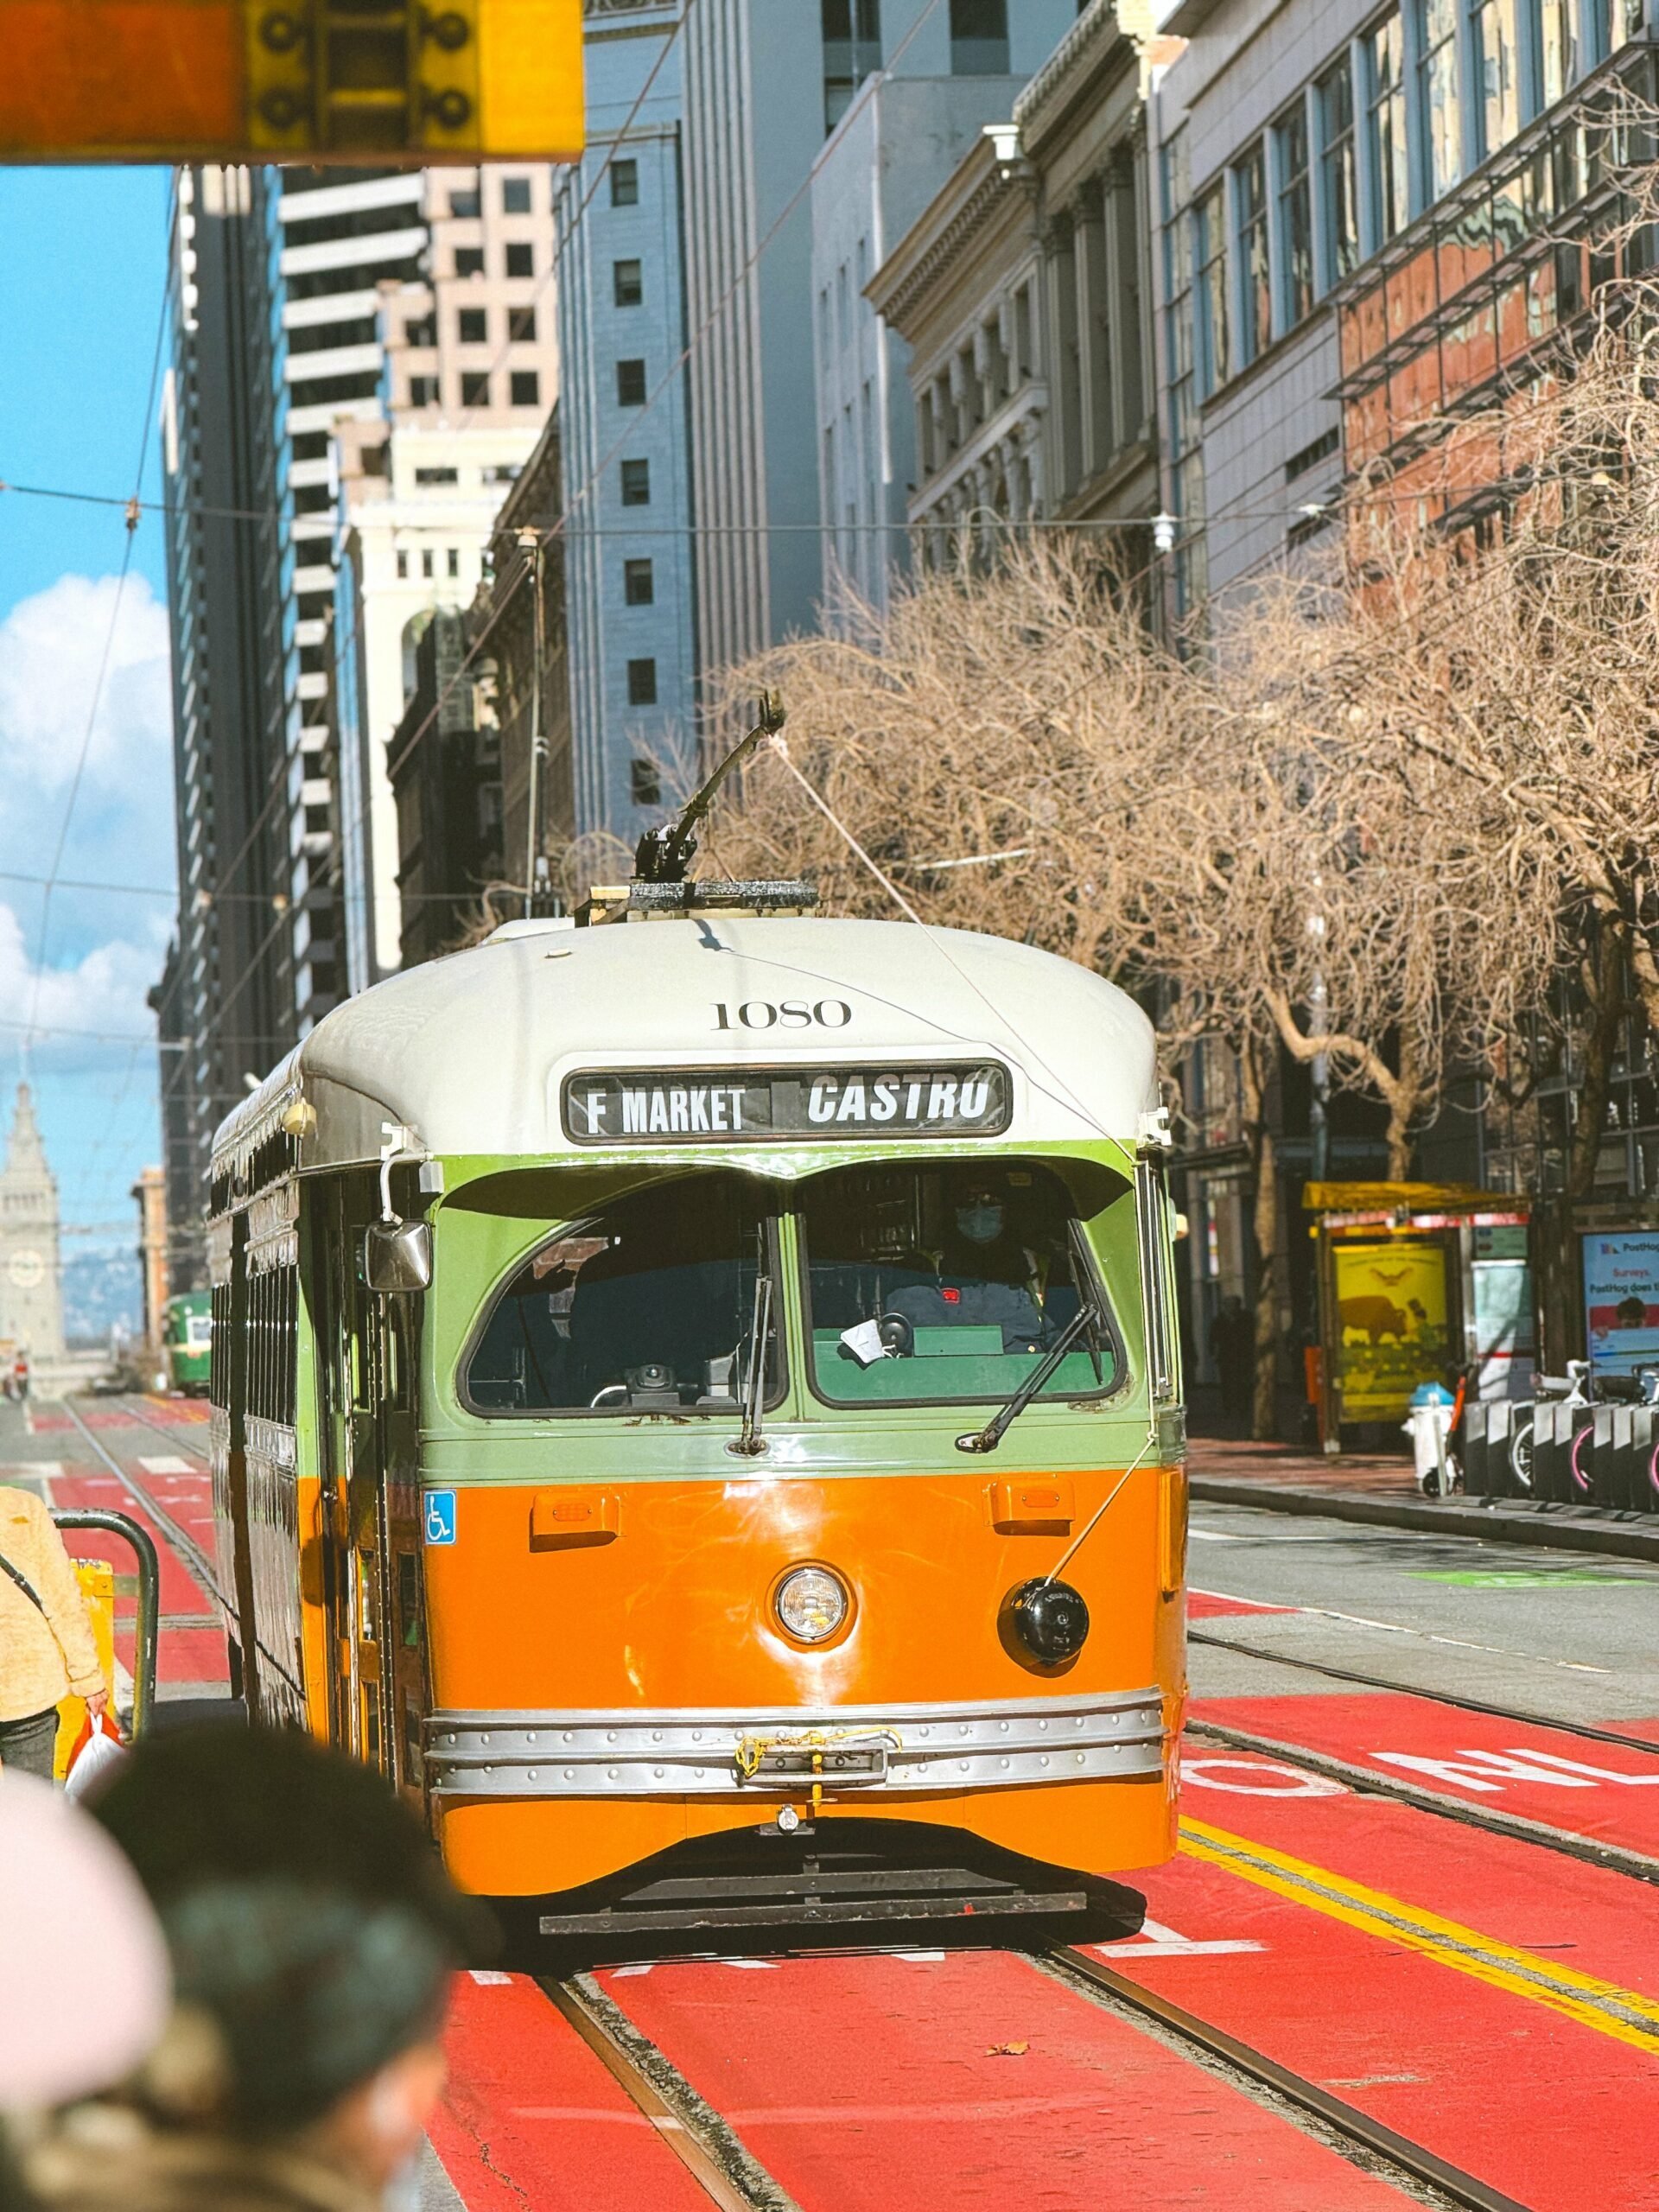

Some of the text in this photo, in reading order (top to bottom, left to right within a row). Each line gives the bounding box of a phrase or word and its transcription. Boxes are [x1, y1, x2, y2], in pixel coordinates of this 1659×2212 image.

[709, 999, 852, 1031] 1080
[588, 1072, 989, 1134] F MARKET CASTRO
[1590, 1284, 1628, 1294] PostHog
[1630, 1282, 1651, 1293] does
